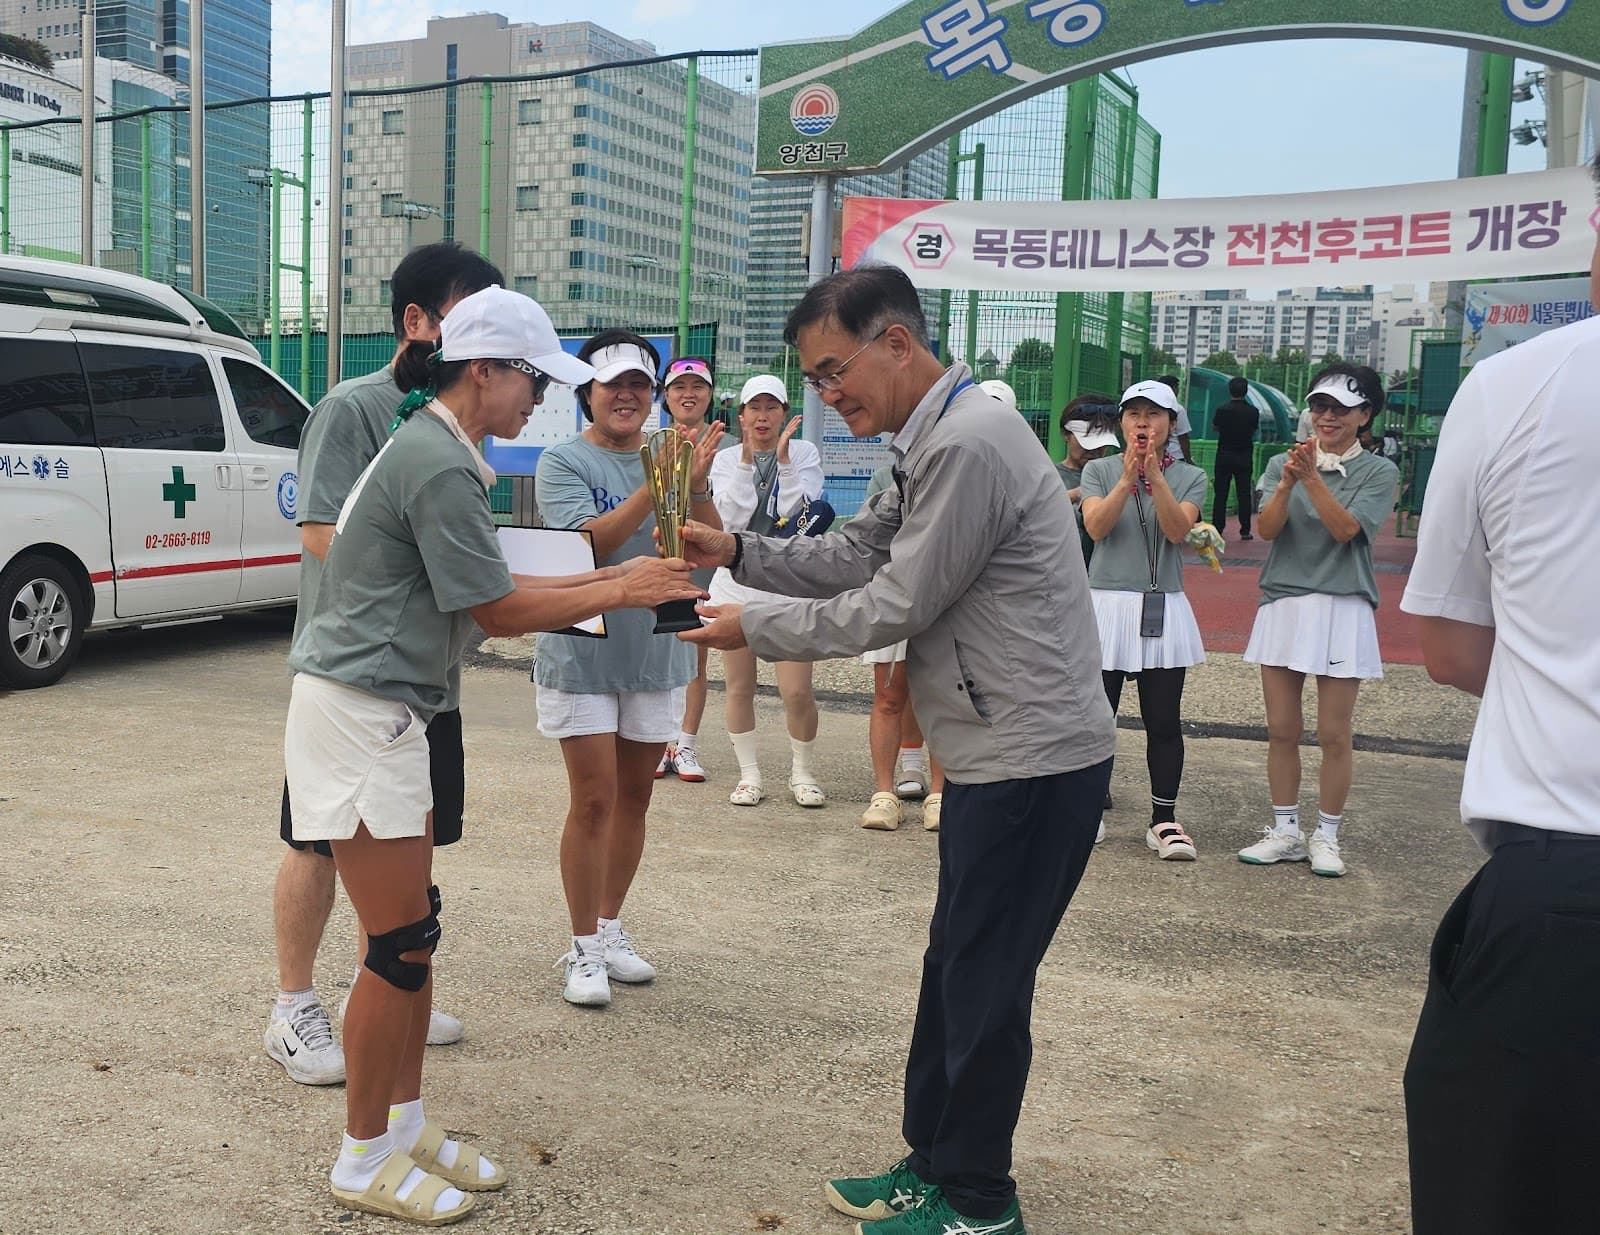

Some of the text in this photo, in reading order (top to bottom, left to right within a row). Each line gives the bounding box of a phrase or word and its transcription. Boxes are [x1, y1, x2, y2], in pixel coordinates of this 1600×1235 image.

[779, 141, 849, 165] 양천구
[916, 200, 1567, 270] 경 목동테니스장 전천후코트 개장
[1487, 303, 1529, 326] 제30회
[54, 457, 70, 479] 솔
[145, 530, 212, 549] 02-2663-8119
